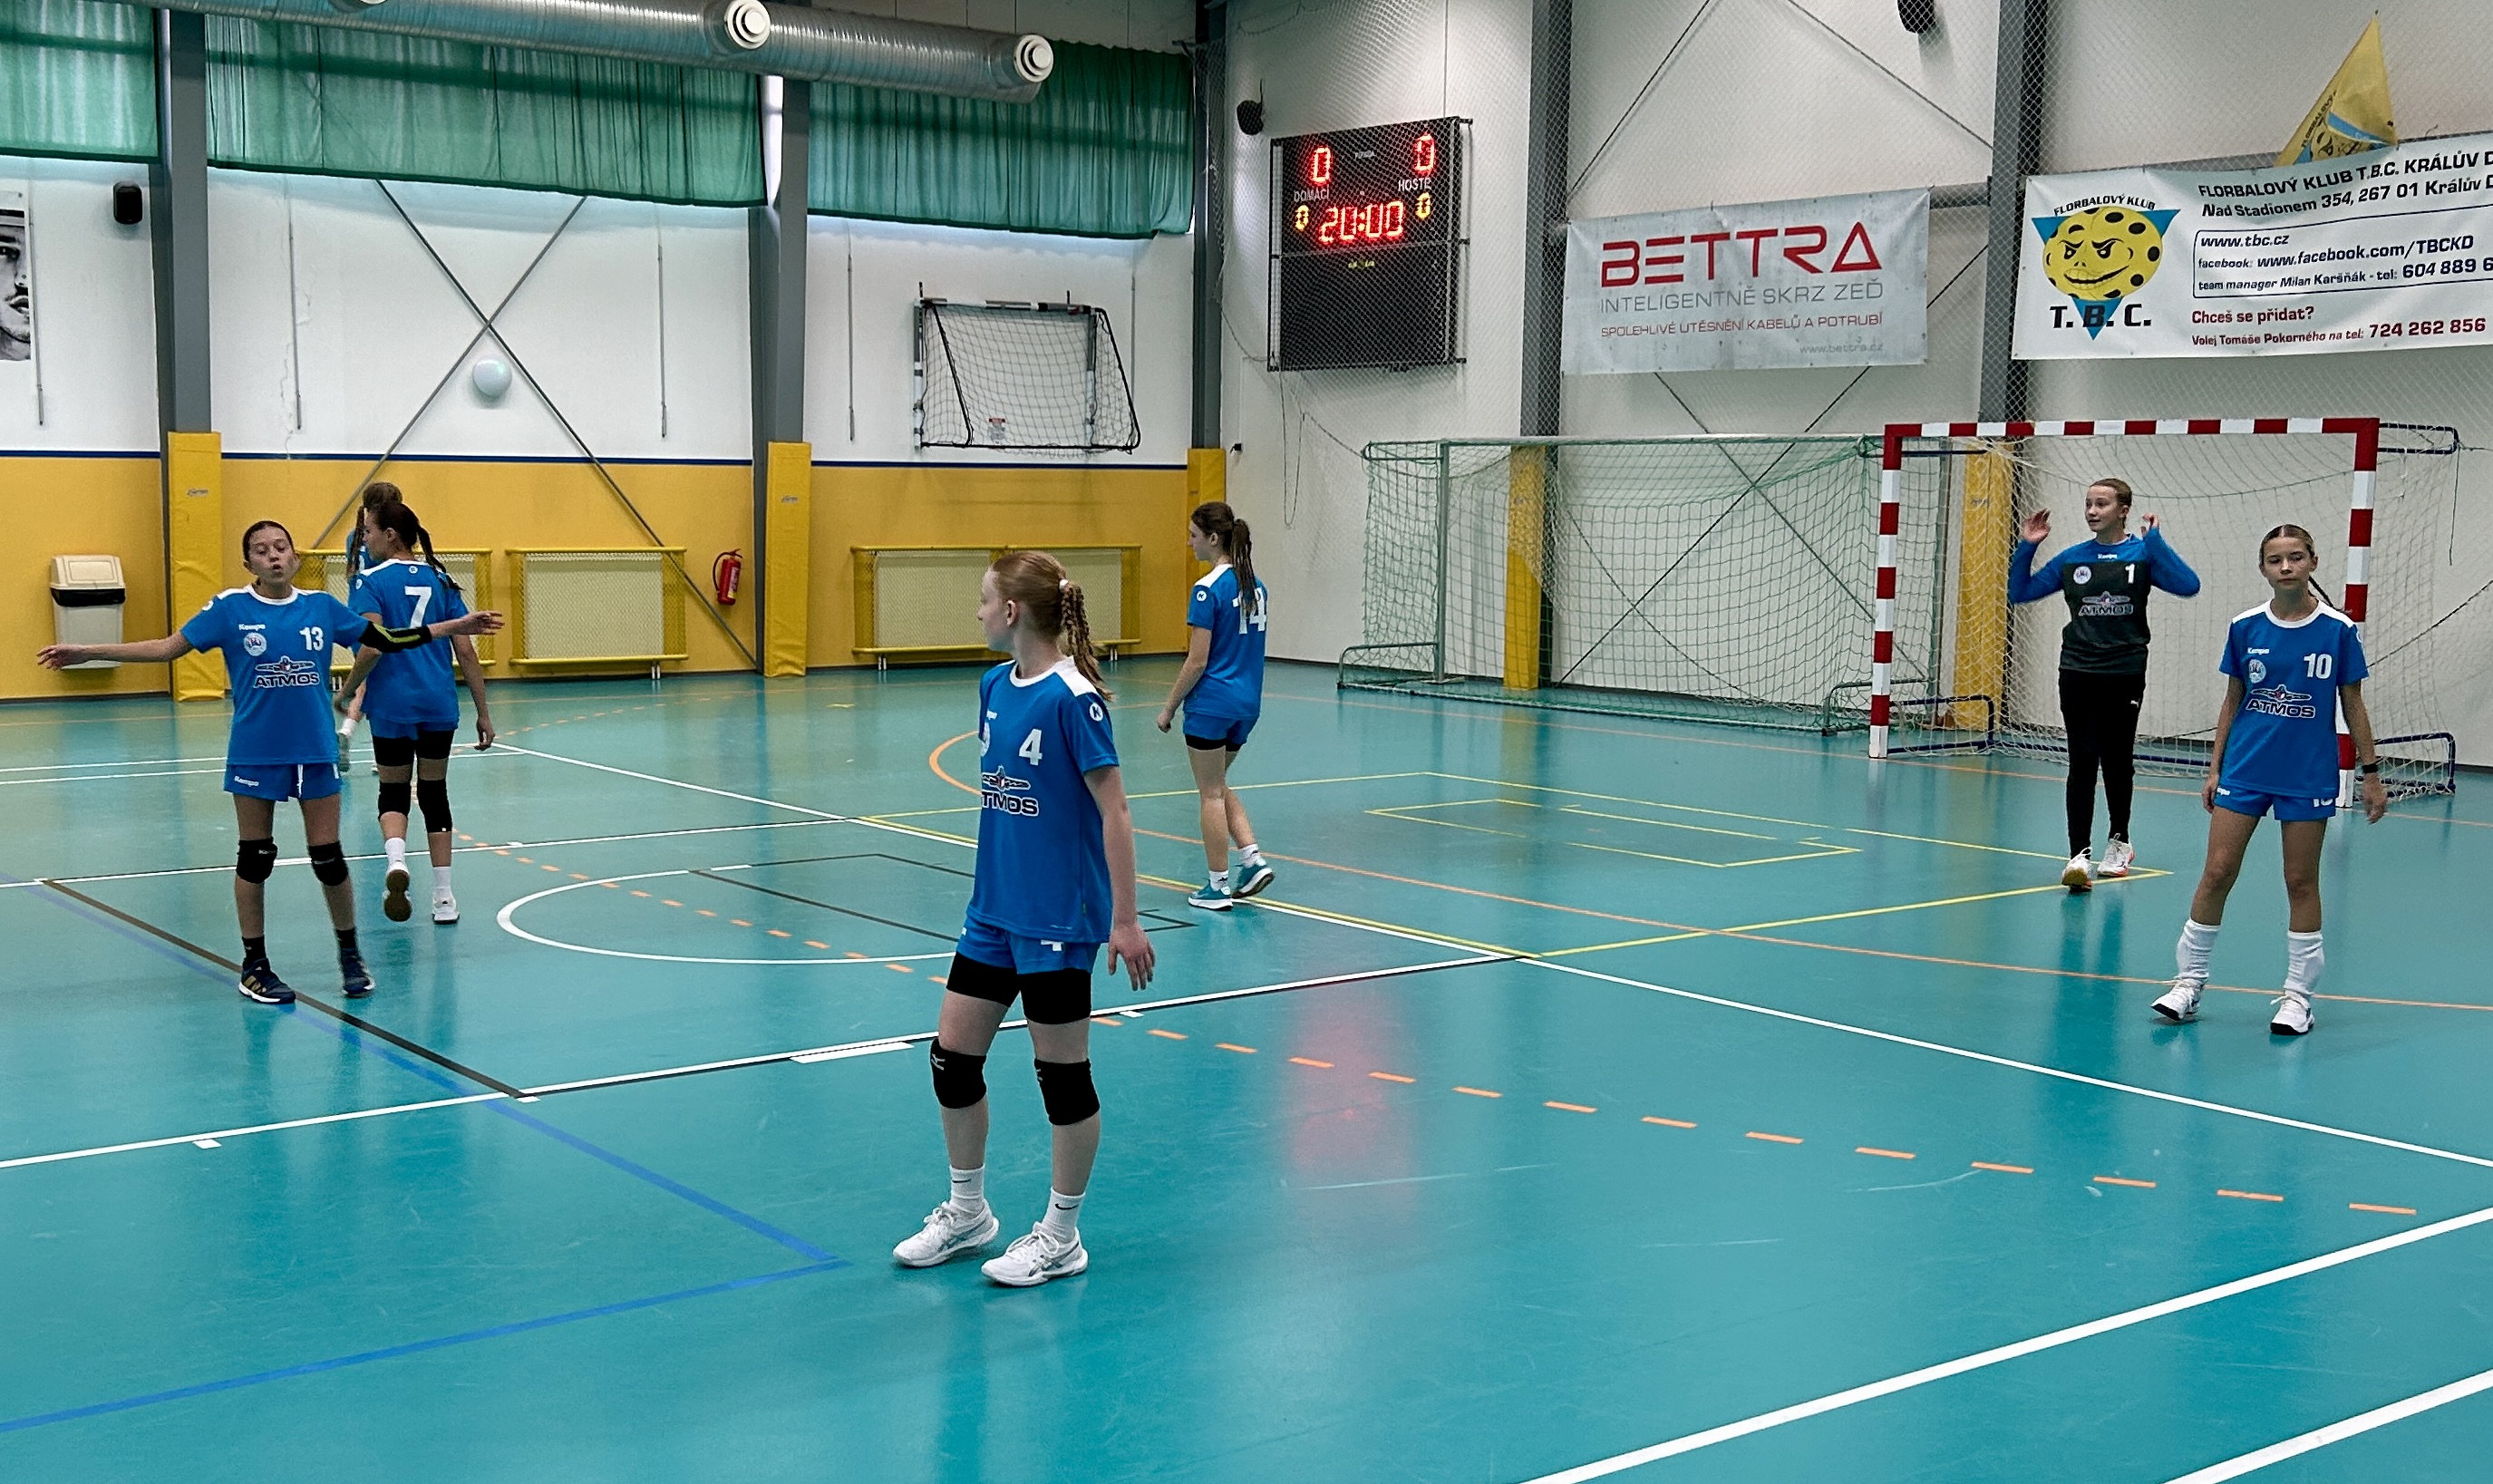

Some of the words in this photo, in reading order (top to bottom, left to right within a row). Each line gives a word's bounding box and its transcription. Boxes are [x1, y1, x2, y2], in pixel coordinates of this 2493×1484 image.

[1312, 147, 1332, 183] 0
[2198, 176, 2298, 197] FLORBALOVÝ
[2304, 170, 2353, 190] KLUB
[2356, 161, 2400, 180] T.B.C.
[2404, 150, 2479, 174] KRÁLŮV
[2053, 193, 2125, 216] FLORBALOVÝ
[2127, 195, 2156, 210] KLUB
[2202, 203, 2233, 217] Nad
[2235, 199, 2317, 217] Stadionem
[2321, 191, 2354, 209] 354,
[2358, 185, 2391, 202] 267
[2396, 182, 2419, 199] 01
[2425, 177, 2482, 196] Králův
[1319, 199, 1404, 244] 20:00
[1601, 221, 1883, 288] BETTRA
[2198, 258, 2253, 269] facebook:
[2257, 235, 2474, 267] www.facebook.com/TBCKD
[2200, 234, 2290, 247] www.tbc.cz
[2198, 281, 2224, 291] team
[2226, 280, 2277, 292] manager
[2280, 276, 2311, 287] Milan
[2377, 269, 2398, 281] tel:
[2402, 262, 2437, 278] 604
[2440, 258, 2477, 275] 889
[1601, 285, 1756, 314] INTELIGENTNĚ
[1762, 285, 1826, 305] SKRZ
[1834, 276, 1883, 301] ZEĎ
[1601, 321, 1676, 338] SPOLEHLIVÉ
[1680, 317, 1744, 334] UTĚSNĚNÍ
[1747, 314, 1800, 330] KABELŮ
[1804, 317, 1814, 327] A
[1818, 311, 1883, 327] POTRUBÍ
[2192, 309, 2233, 324] Chceš
[2236, 310, 2253, 323] se
[2257, 306, 2314, 325] přidat?
[2192, 335, 2217, 346] Volej
[2219, 333, 2261, 345] Tomáše
[2264, 330, 2326, 344] Pokorného
[2329, 332, 2343, 341] na
[2345, 328, 2364, 339] tel:
[2369, 323, 2403, 339] 724
[2408, 320, 2444, 336] 262
[2449, 317, 2487, 334] 856
[1799, 343, 1884, 354] www.bettra.cz
[2125, 563, 2136, 584] 1
[404, 586, 432, 628] 7
[1233, 587, 1267, 635] 14
[299, 626, 325, 652] 13
[253, 672, 320, 689] ATMOS
[2304, 653, 2333, 680] 10
[2245, 698, 2316, 719] ATMOS
[1018, 728, 1043, 766] 4
[981, 789, 1040, 817] TMOS
